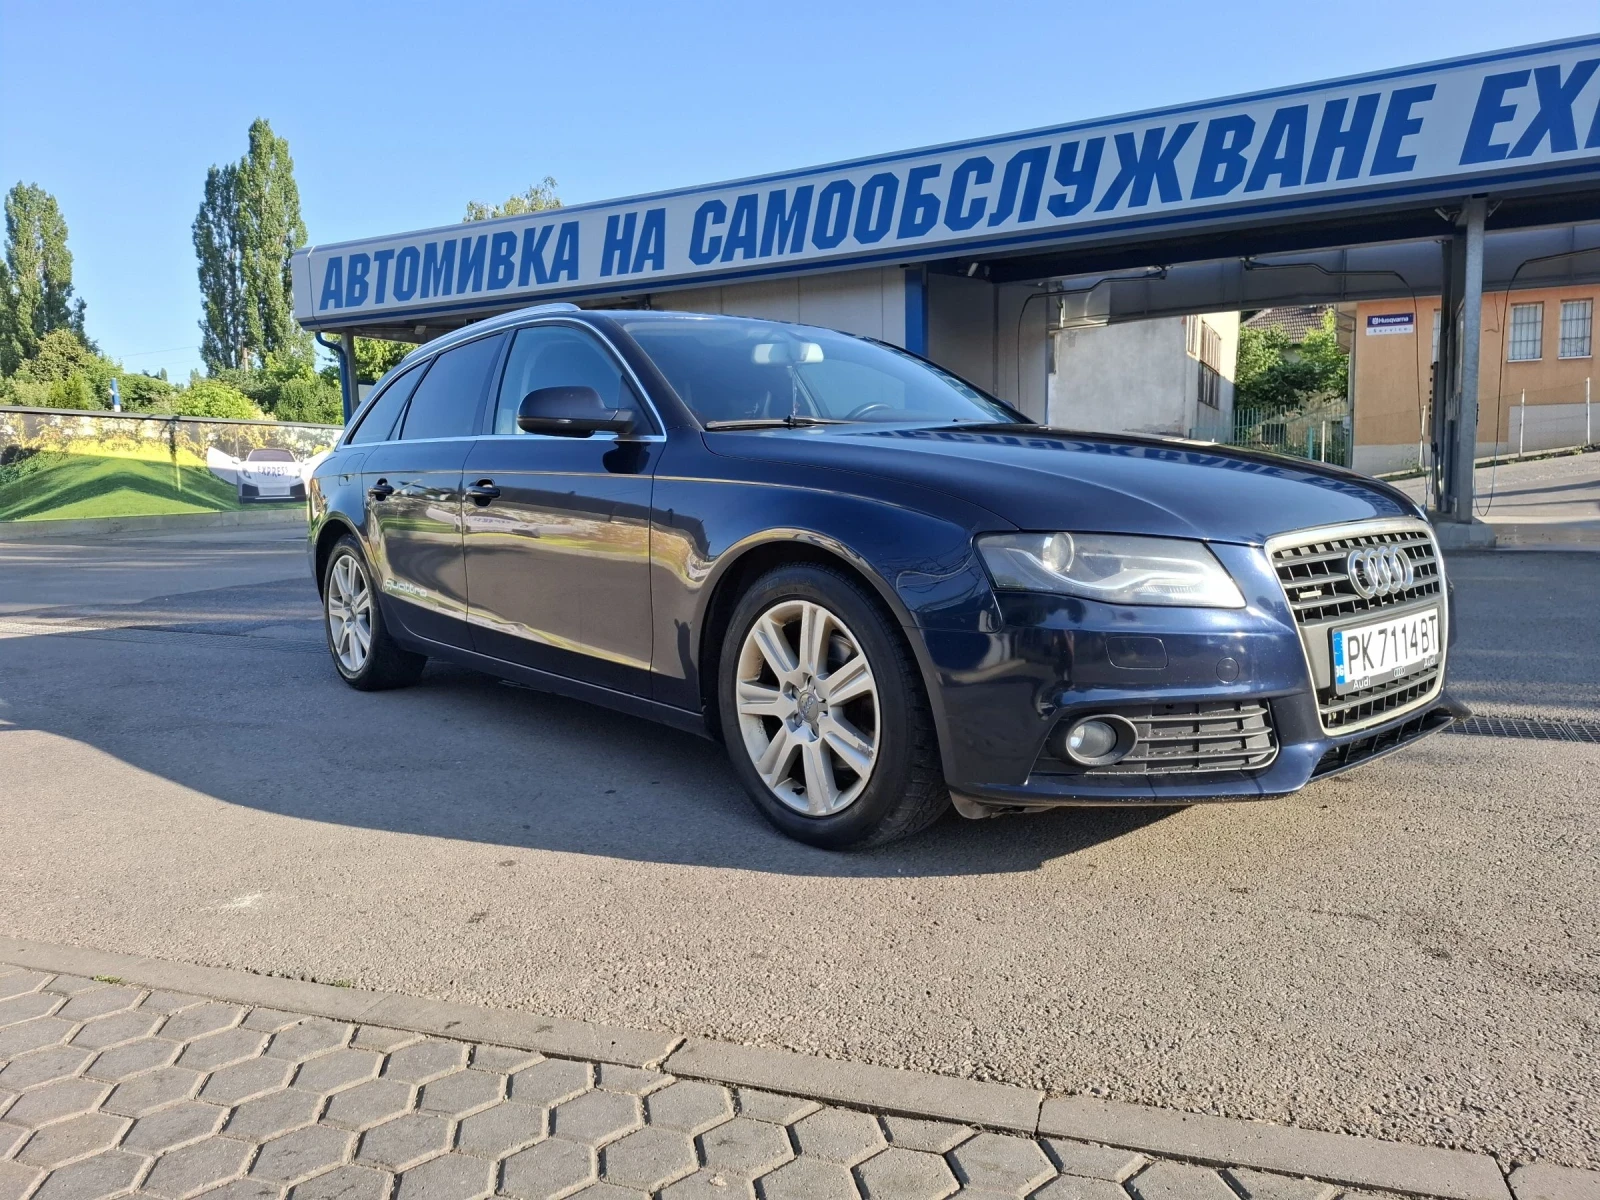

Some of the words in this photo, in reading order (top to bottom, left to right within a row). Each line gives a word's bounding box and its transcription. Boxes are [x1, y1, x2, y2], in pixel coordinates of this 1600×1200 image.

[319, 220, 580, 311] АВТОМИВКА
[599, 207, 666, 277] НА
[689, 83, 1437, 265] САМООБСЛУЖВАНЕ
[1458, 58, 1600, 166] EX
[1378, 316, 1409, 324] Husqvarna
[257, 465, 289, 478] EXPRESS
[384, 579, 428, 597] quattro
[1353, 676, 1371, 690] Audi
[1423, 656, 1436, 669] Audi
